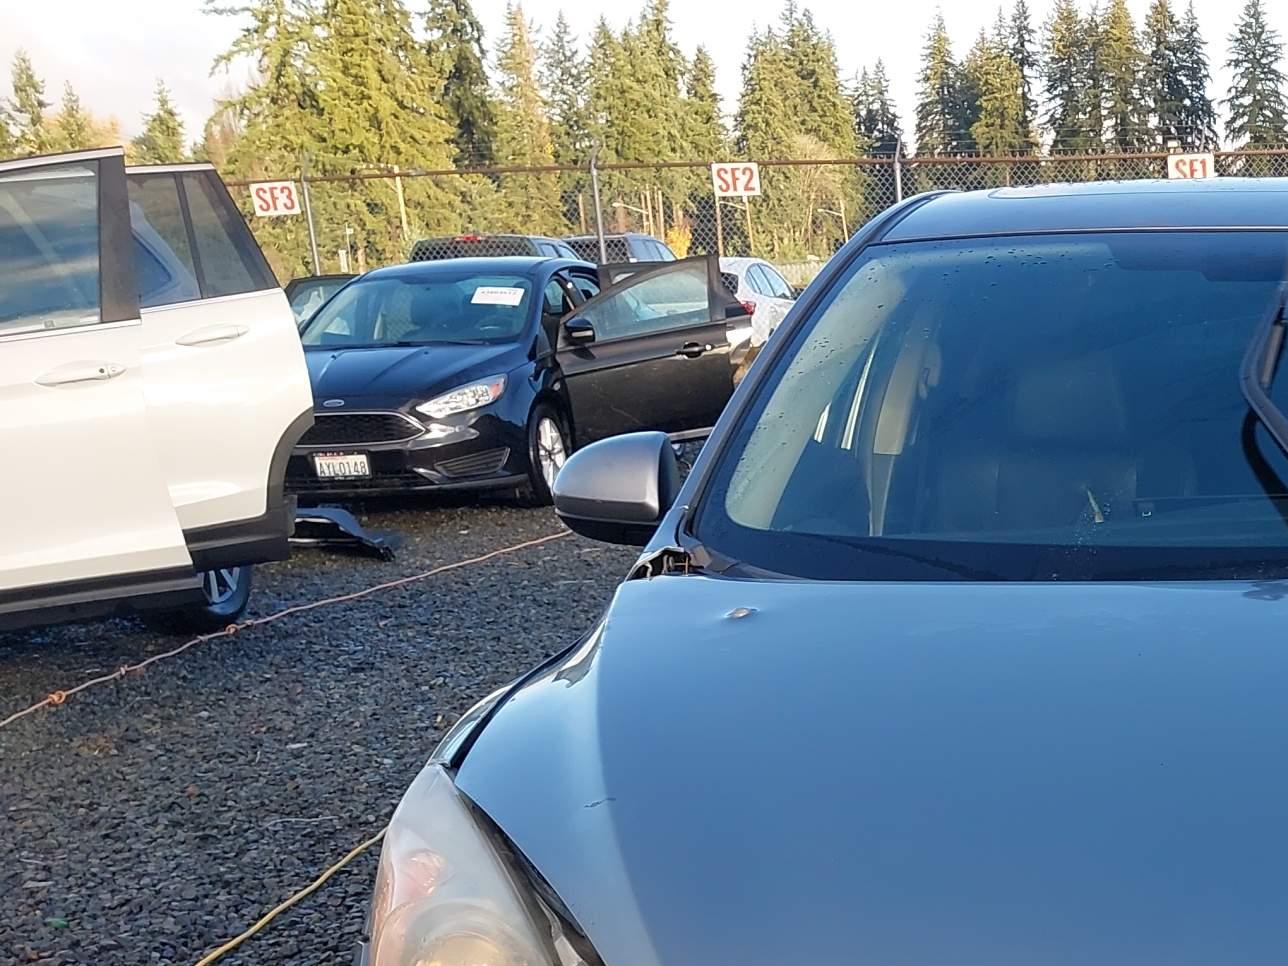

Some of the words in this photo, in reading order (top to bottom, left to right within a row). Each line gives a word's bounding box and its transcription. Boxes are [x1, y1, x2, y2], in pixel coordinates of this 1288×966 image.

[1174, 158, 1208, 178] SF1
[716, 167, 757, 193] SF2
[255, 186, 295, 212] SF3
[319, 460, 368, 477] AYL0148
